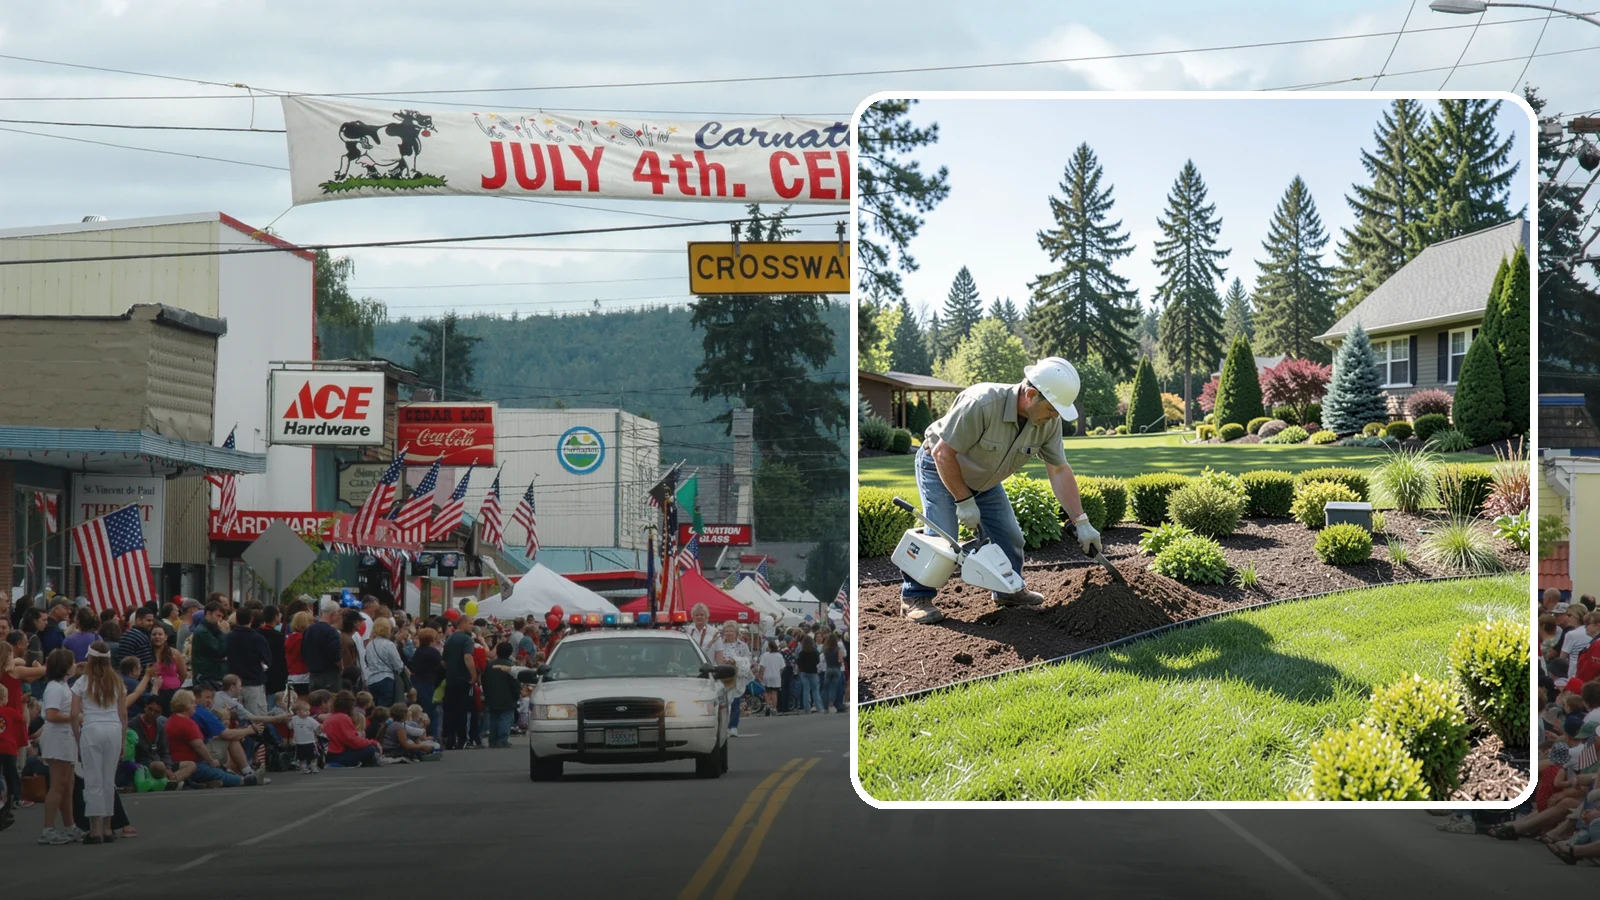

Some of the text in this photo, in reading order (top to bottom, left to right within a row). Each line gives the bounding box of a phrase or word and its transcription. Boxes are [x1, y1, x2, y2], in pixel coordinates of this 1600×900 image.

[695, 121, 850, 150] Carnat
[481, 140, 605, 192] JULY
[632, 150, 747, 197] 4th.
[696, 254, 850, 280] CROSSWA
[283, 380, 374, 420] ACE
[406, 409, 452, 422] CEDAR
[283, 421, 371, 436] Hardware
[354, 467, 386, 480] Simpl
[83, 485, 155, 495] St. Vincent de Paul
[688, 526, 742, 535] CRNATION
[699, 535, 730, 543] GLASS
